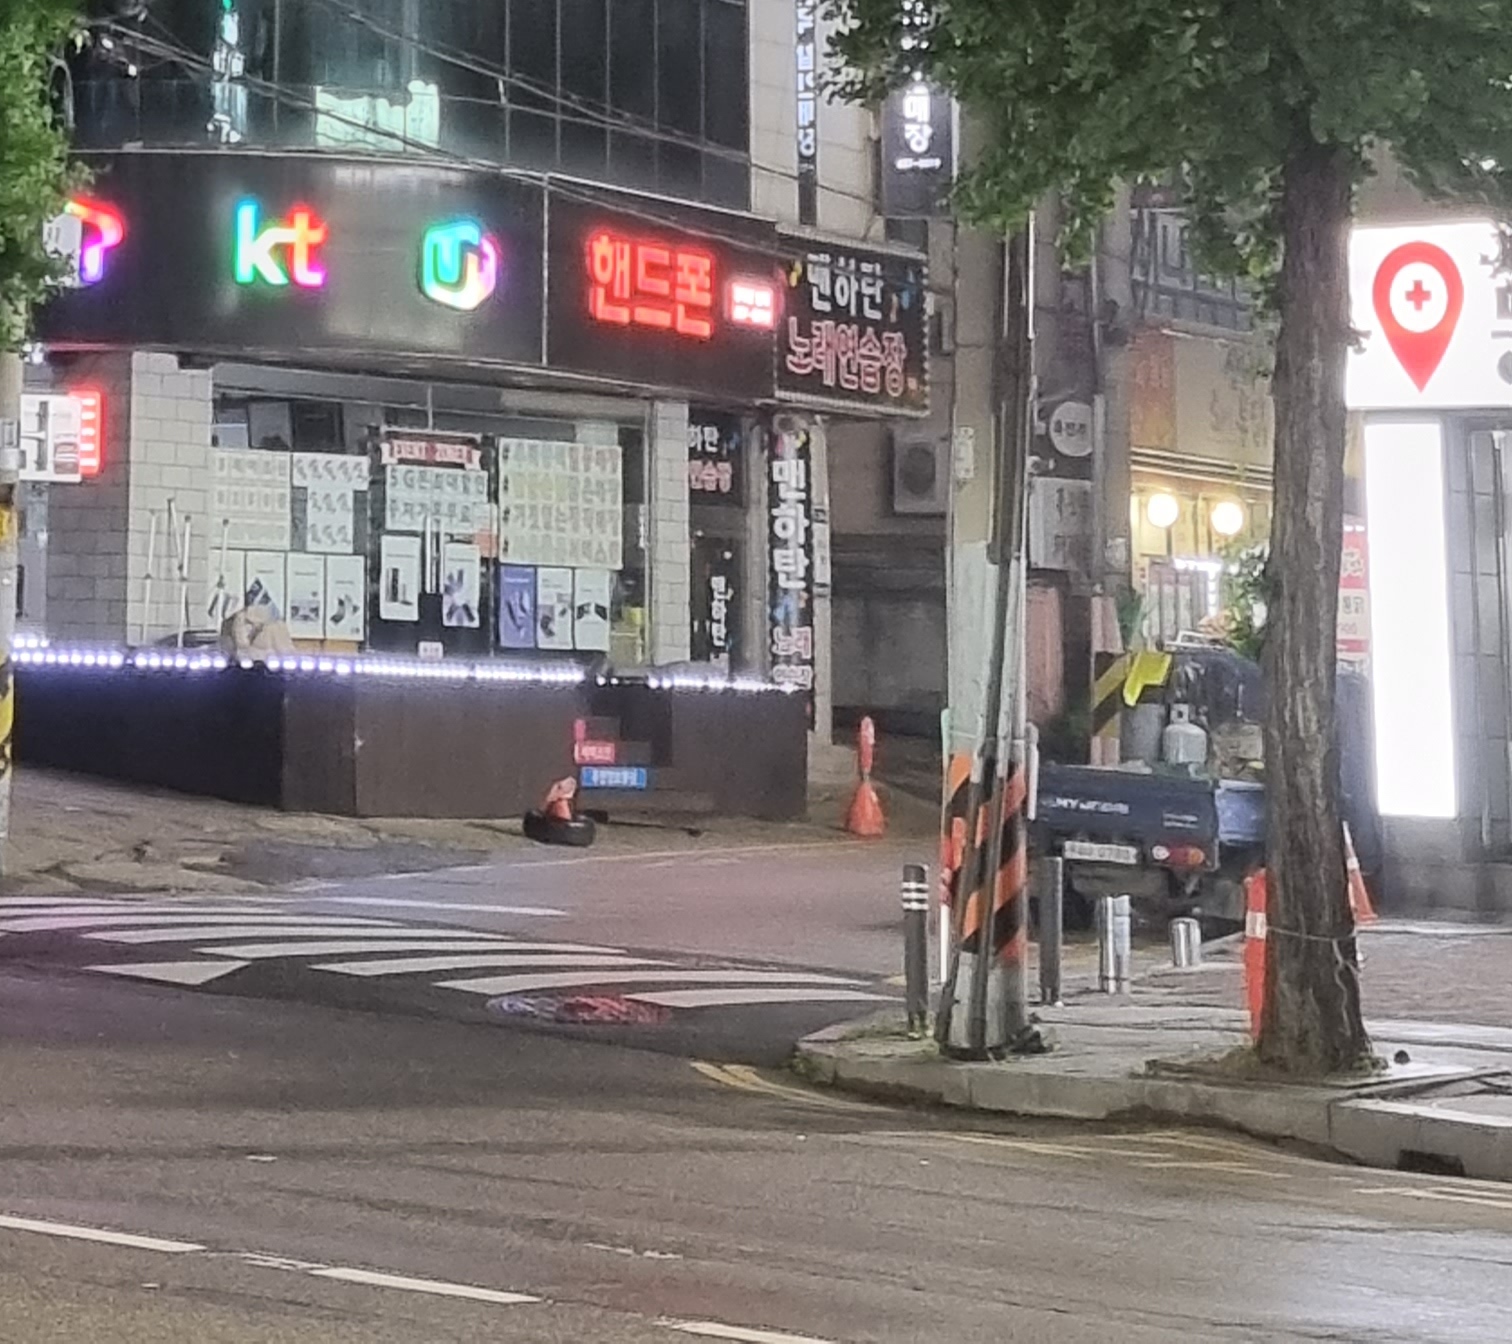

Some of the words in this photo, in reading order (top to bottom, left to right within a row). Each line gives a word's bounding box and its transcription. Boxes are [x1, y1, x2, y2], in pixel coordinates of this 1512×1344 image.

[234, 197, 327, 287] kt
[589, 233, 714, 339] 핸드폰
[786, 315, 908, 398] 노래연습장
[771, 458, 811, 589] 맨하탄
